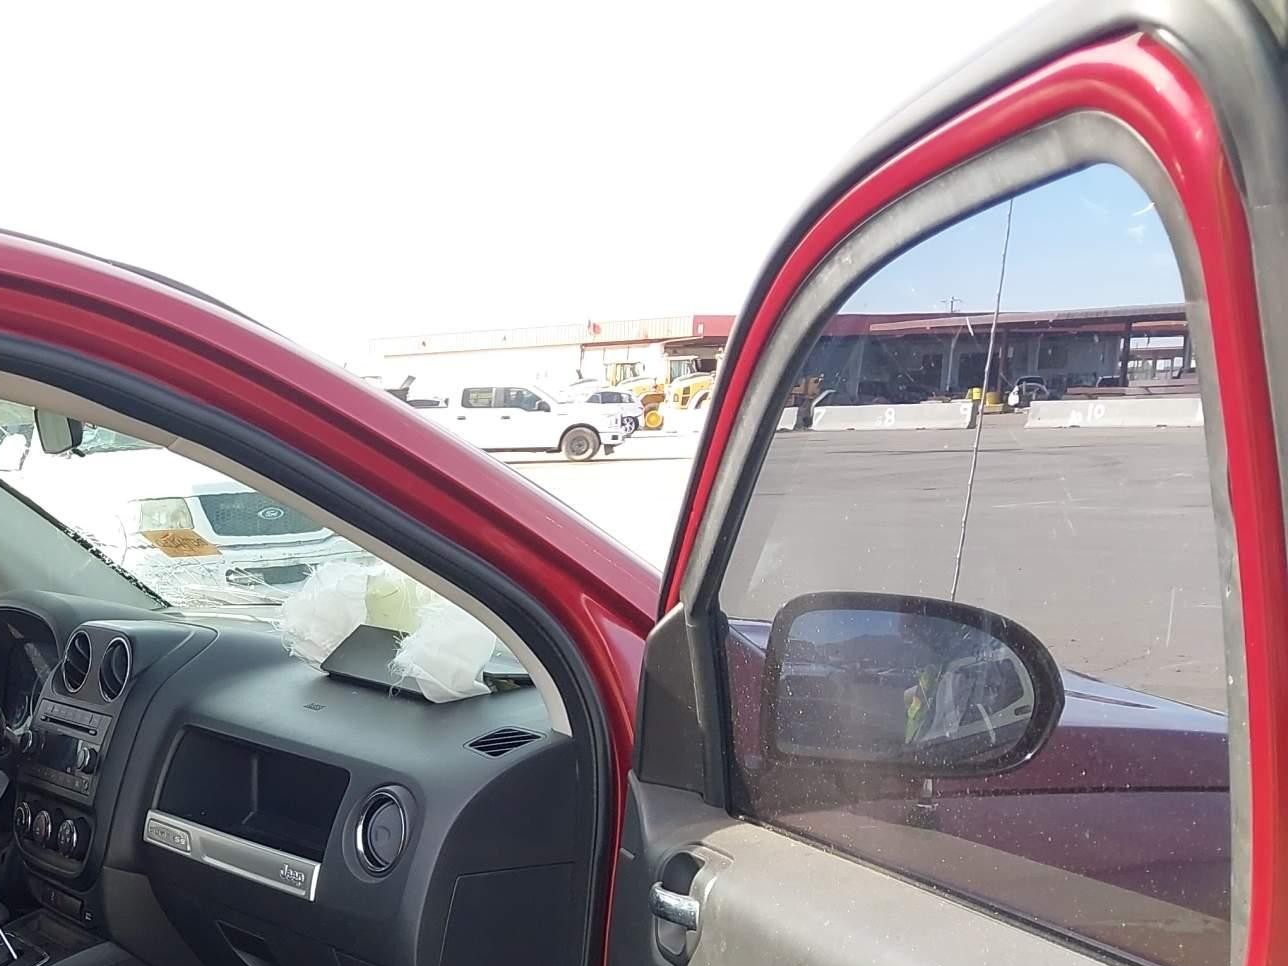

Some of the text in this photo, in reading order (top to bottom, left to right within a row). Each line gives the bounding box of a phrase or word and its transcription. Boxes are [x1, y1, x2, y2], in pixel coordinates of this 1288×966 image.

[884, 407, 896, 426] 8
[1087, 402, 1105, 422] 10
[279, 862, 305, 887] Jeep
